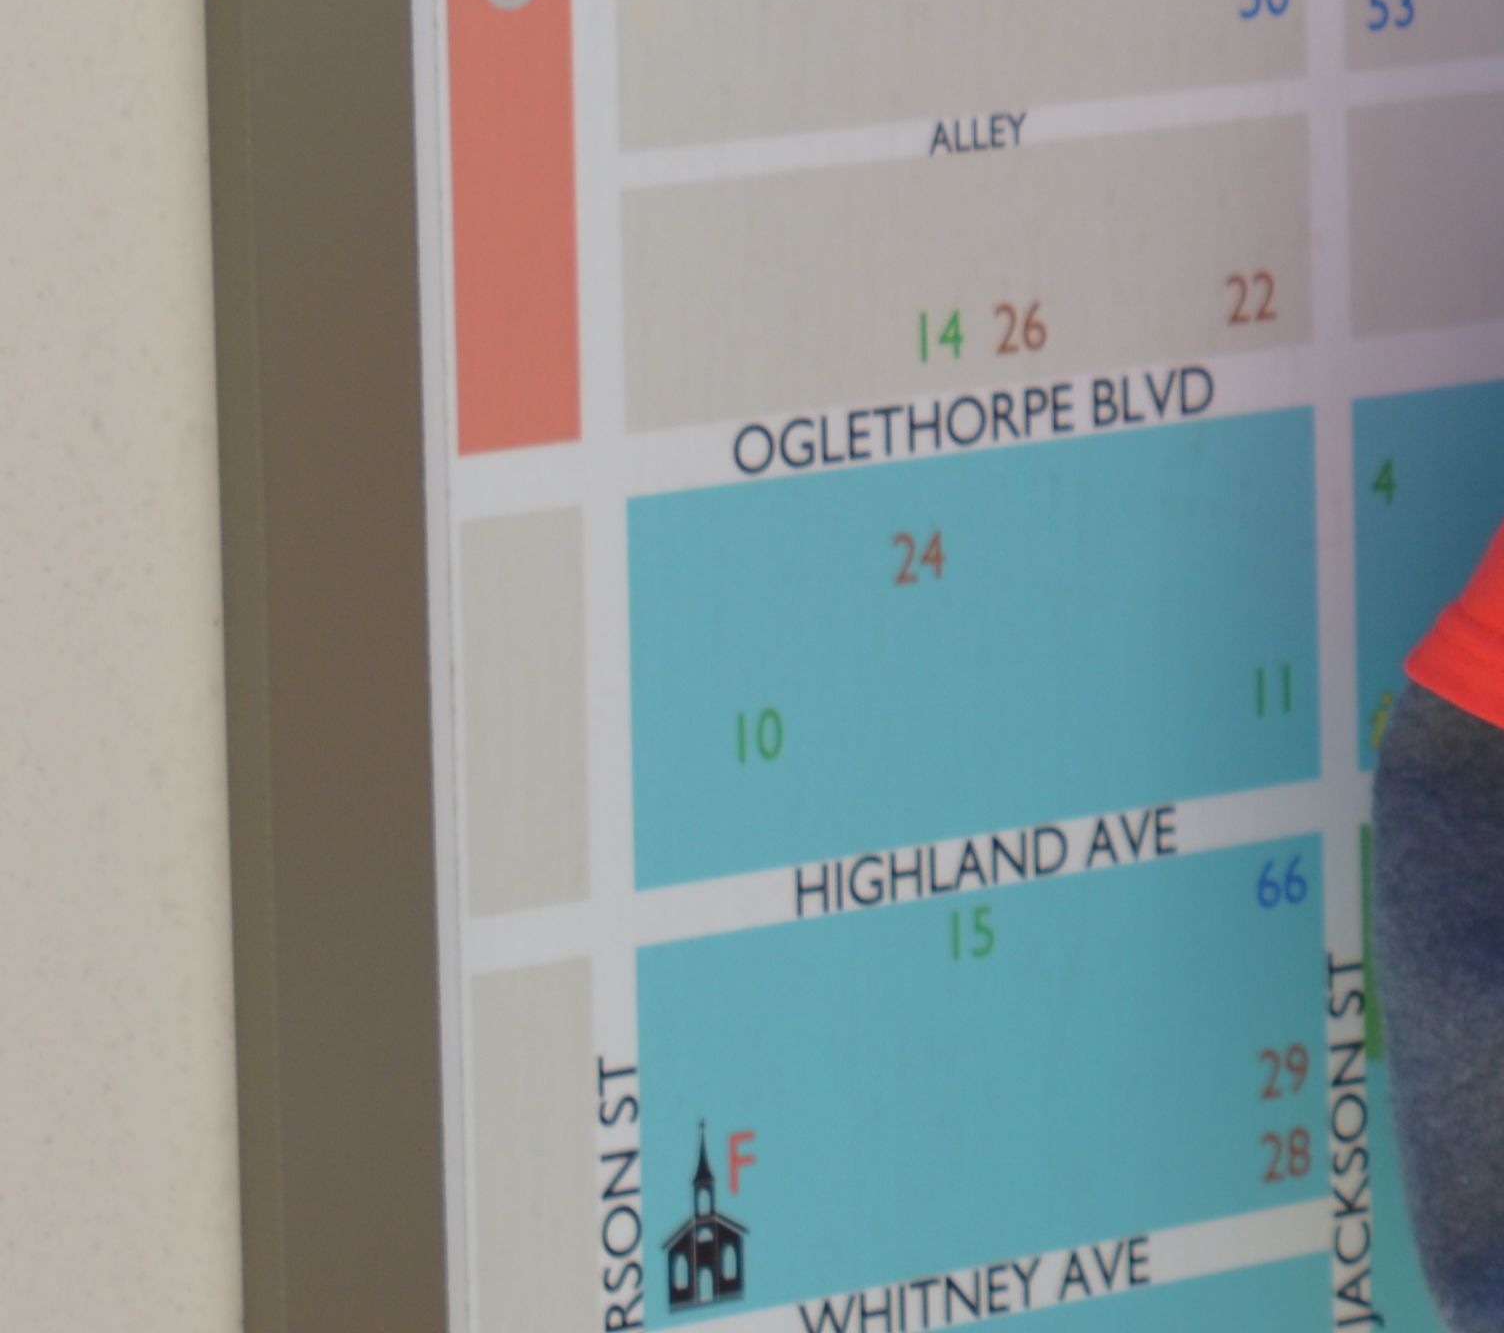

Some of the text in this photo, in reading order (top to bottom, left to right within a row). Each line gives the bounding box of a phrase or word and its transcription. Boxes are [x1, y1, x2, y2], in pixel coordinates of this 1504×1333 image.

[929, 111, 1027, 156] ALLEY
[1224, 271, 1278, 325] 22
[919, 301, 1048, 362] 14 26
[732, 366, 1214, 475] OGLETHORPE BLVD
[1370, 457, 1397, 504] 4
[892, 530, 946, 586] 24
[736, 707, 783, 764] 10
[796, 805, 1178, 916] HIGHLAND AVE
[1256, 856, 1309, 909] 66
[950, 904, 996, 961] 15
[597, 1055, 638, 1125] ST
[1258, 1043, 1310, 1101] 29
[726, 1130, 757, 1196] F
[1260, 1128, 1313, 1183] 28
[1327, 951, 1384, 1330] JACKSON ST
[1058, 1234, 1152, 1300] AVE
